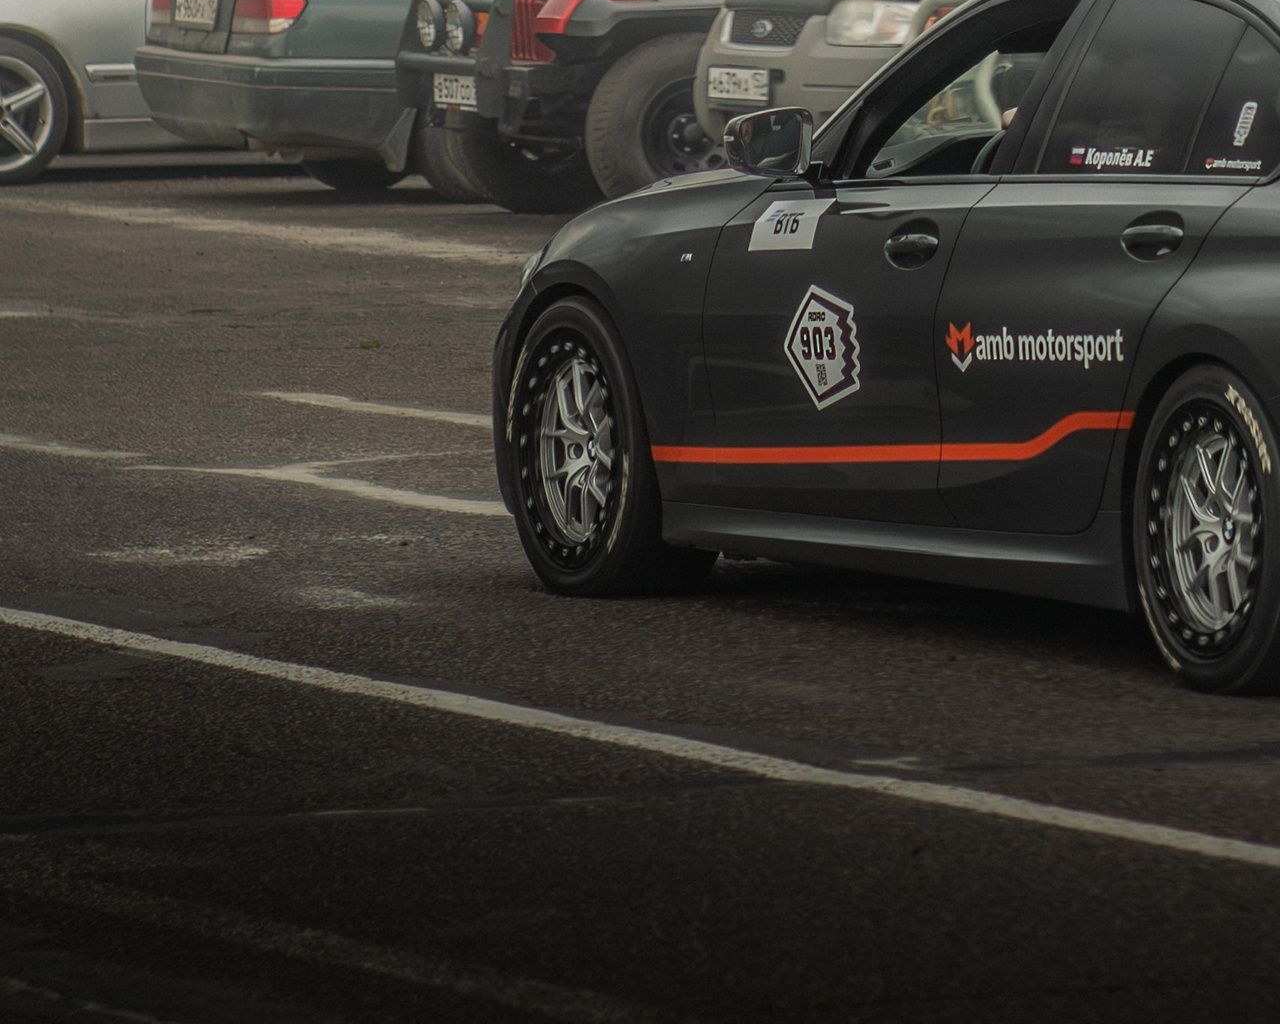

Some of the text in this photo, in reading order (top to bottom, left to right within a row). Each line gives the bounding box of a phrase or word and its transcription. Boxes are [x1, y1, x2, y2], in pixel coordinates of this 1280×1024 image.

[1085, 148, 1133, 170] Королёв
[773, 212, 805, 235] ВТБ
[800, 326, 837, 361] 903
[976, 326, 1125, 369] amb motorsport
